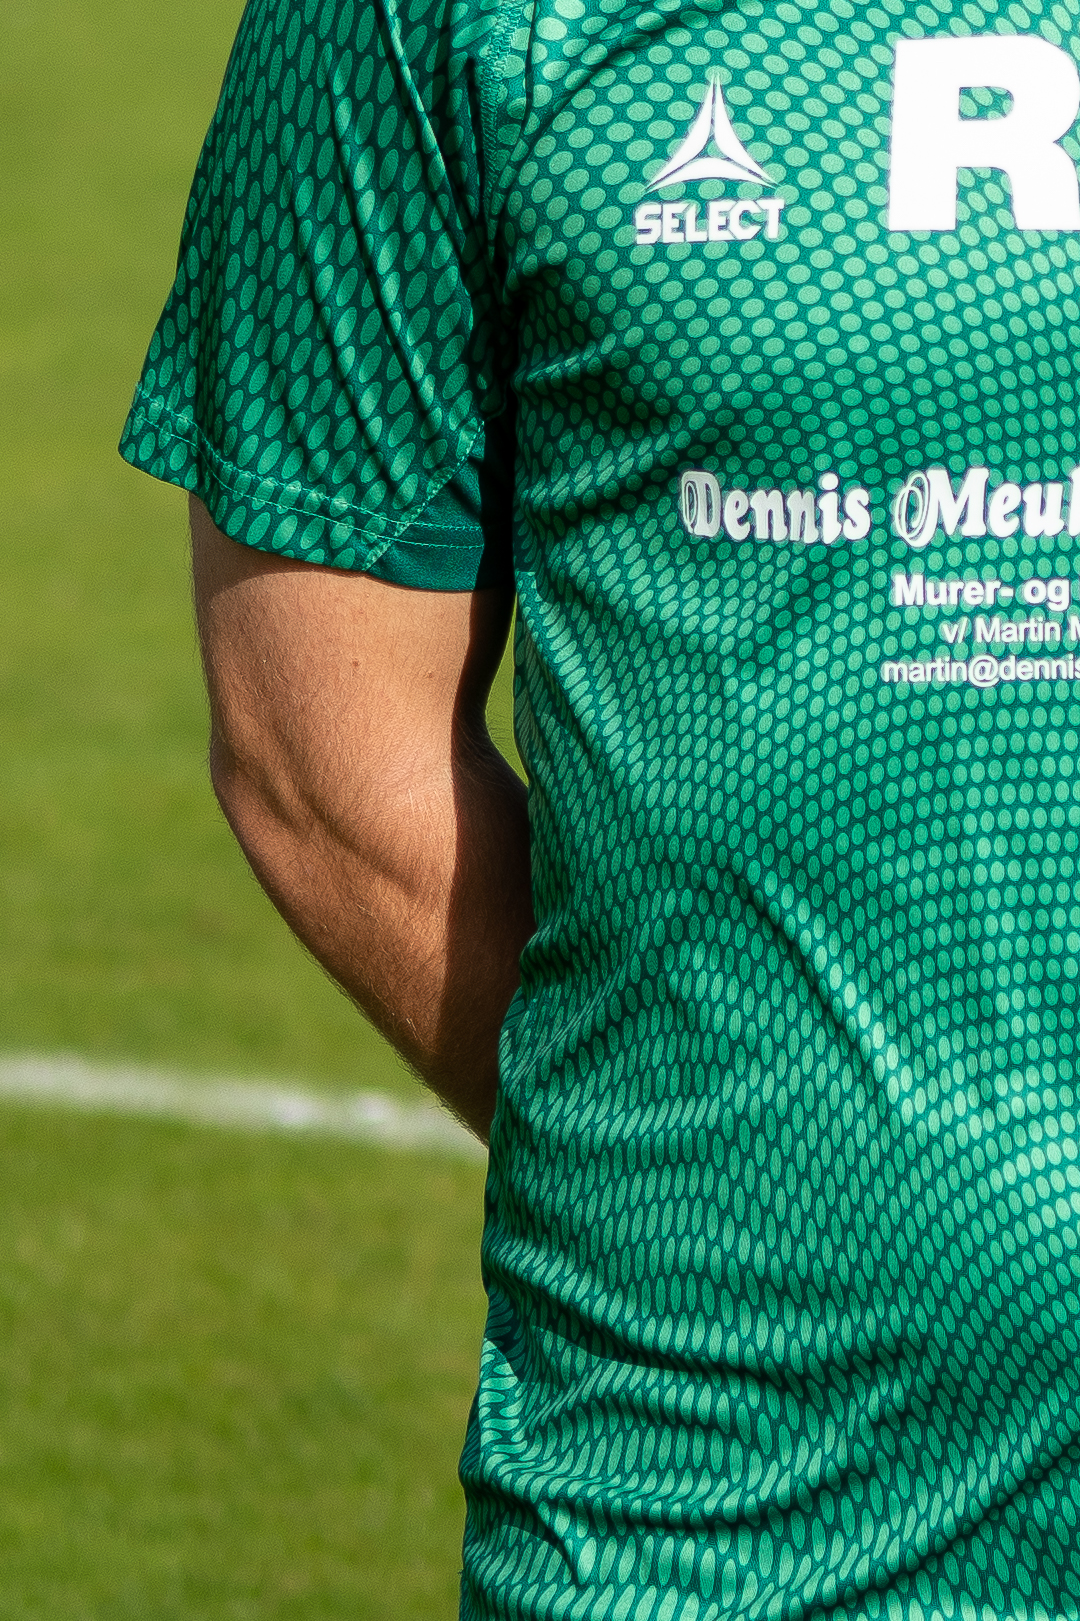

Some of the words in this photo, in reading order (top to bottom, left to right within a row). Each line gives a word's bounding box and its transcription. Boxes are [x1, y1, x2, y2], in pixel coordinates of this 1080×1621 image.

[634, 199, 785, 246] SELECT
[680, 468, 872, 545] Dennis
[893, 573, 1014, 607] Murer-
[1022, 578, 1071, 612] og
[941, 616, 969, 644] v/
[973, 615, 1061, 644] Martin
